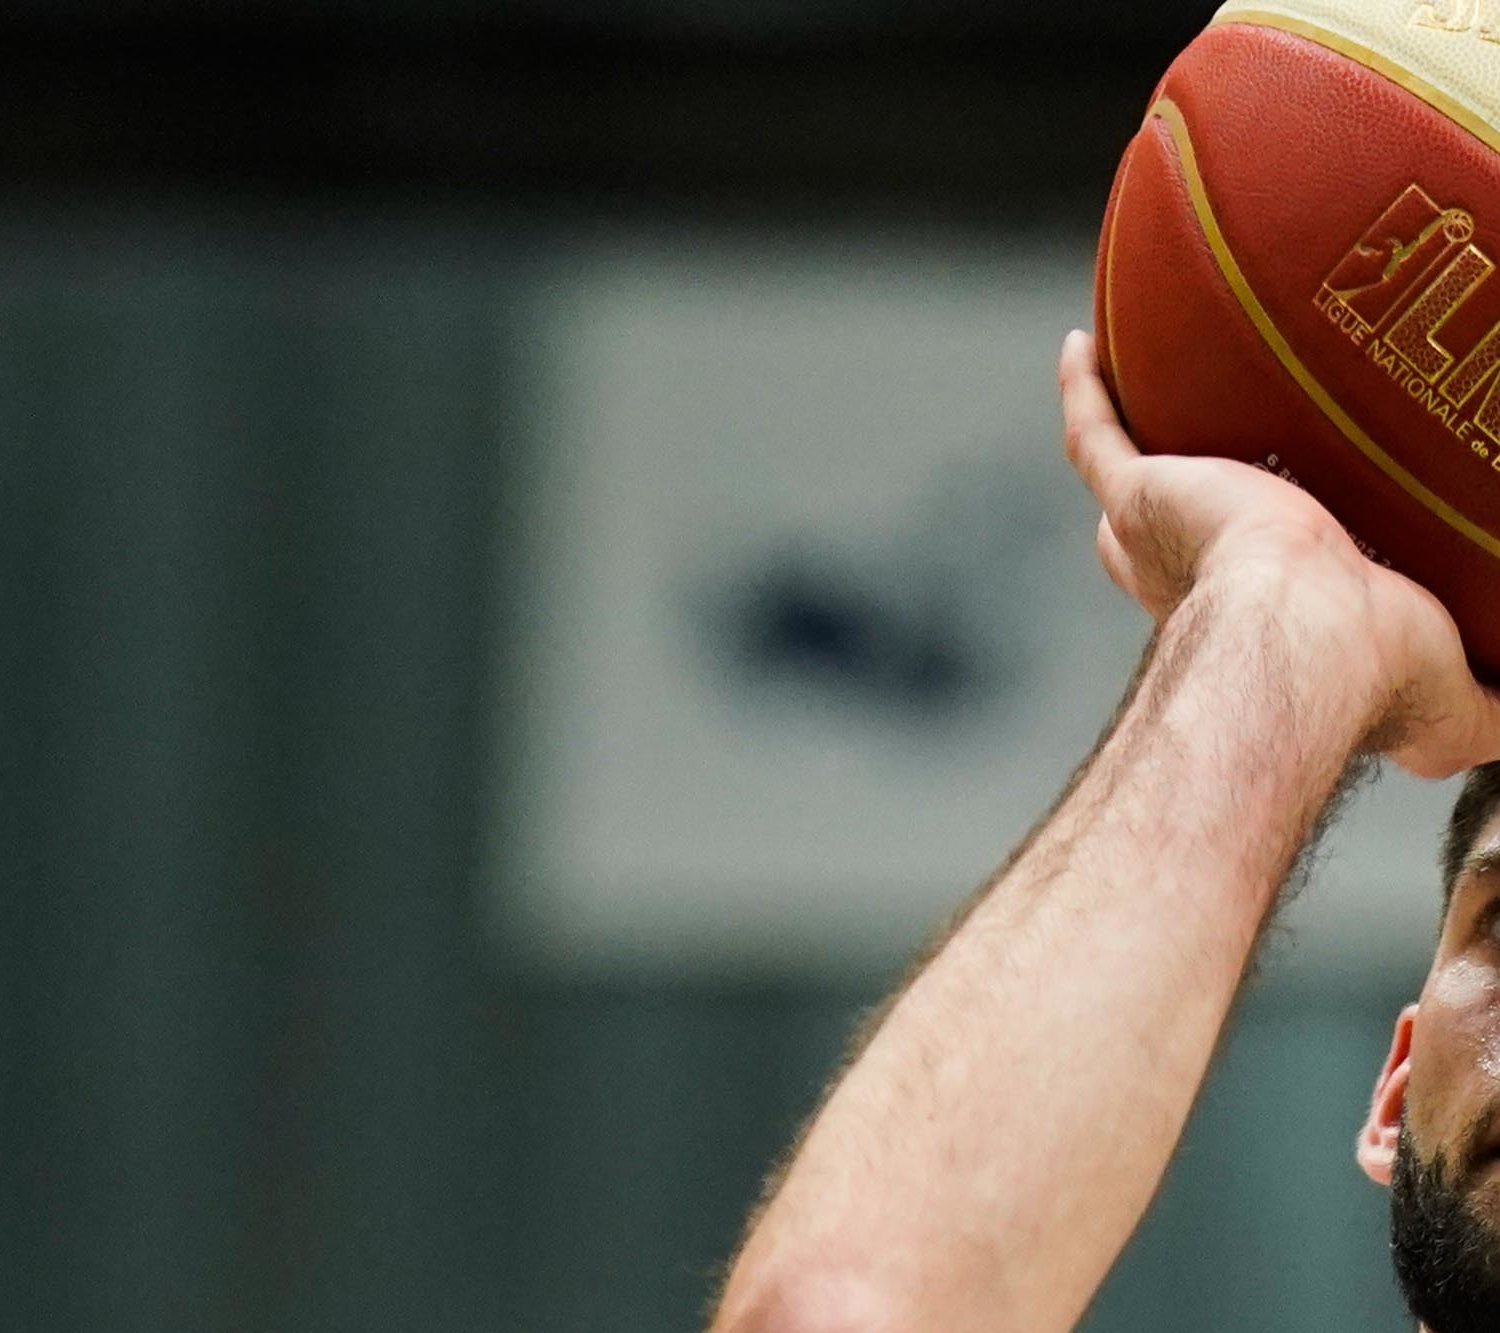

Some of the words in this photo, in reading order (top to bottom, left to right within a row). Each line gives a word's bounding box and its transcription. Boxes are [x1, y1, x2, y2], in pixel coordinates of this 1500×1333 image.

[1312, 284, 1372, 346] LIGUE
[1365, 338, 1473, 440] NATIONALE
[1471, 439, 1489, 459] de
